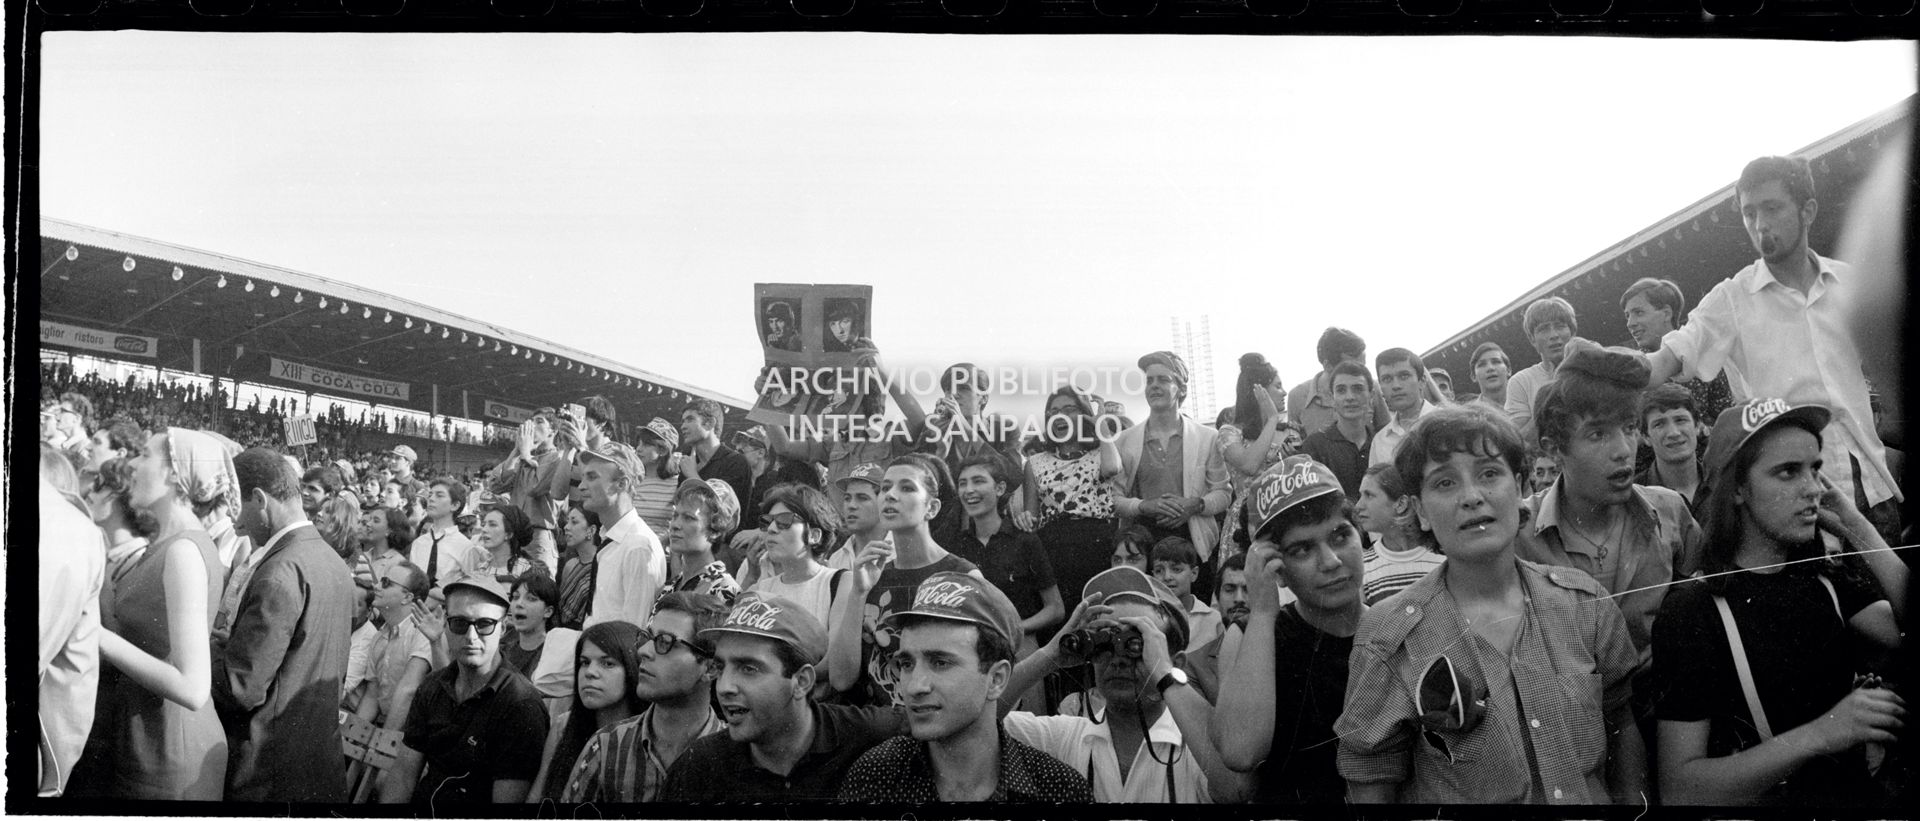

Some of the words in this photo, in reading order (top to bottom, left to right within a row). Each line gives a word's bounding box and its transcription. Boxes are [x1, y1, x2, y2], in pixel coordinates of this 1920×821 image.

[40, 324, 65, 339] iglior
[75, 332, 104, 345] ristoro
[311, 373, 401, 398] COCA-COLA
[285, 417, 315, 445] RINGO
